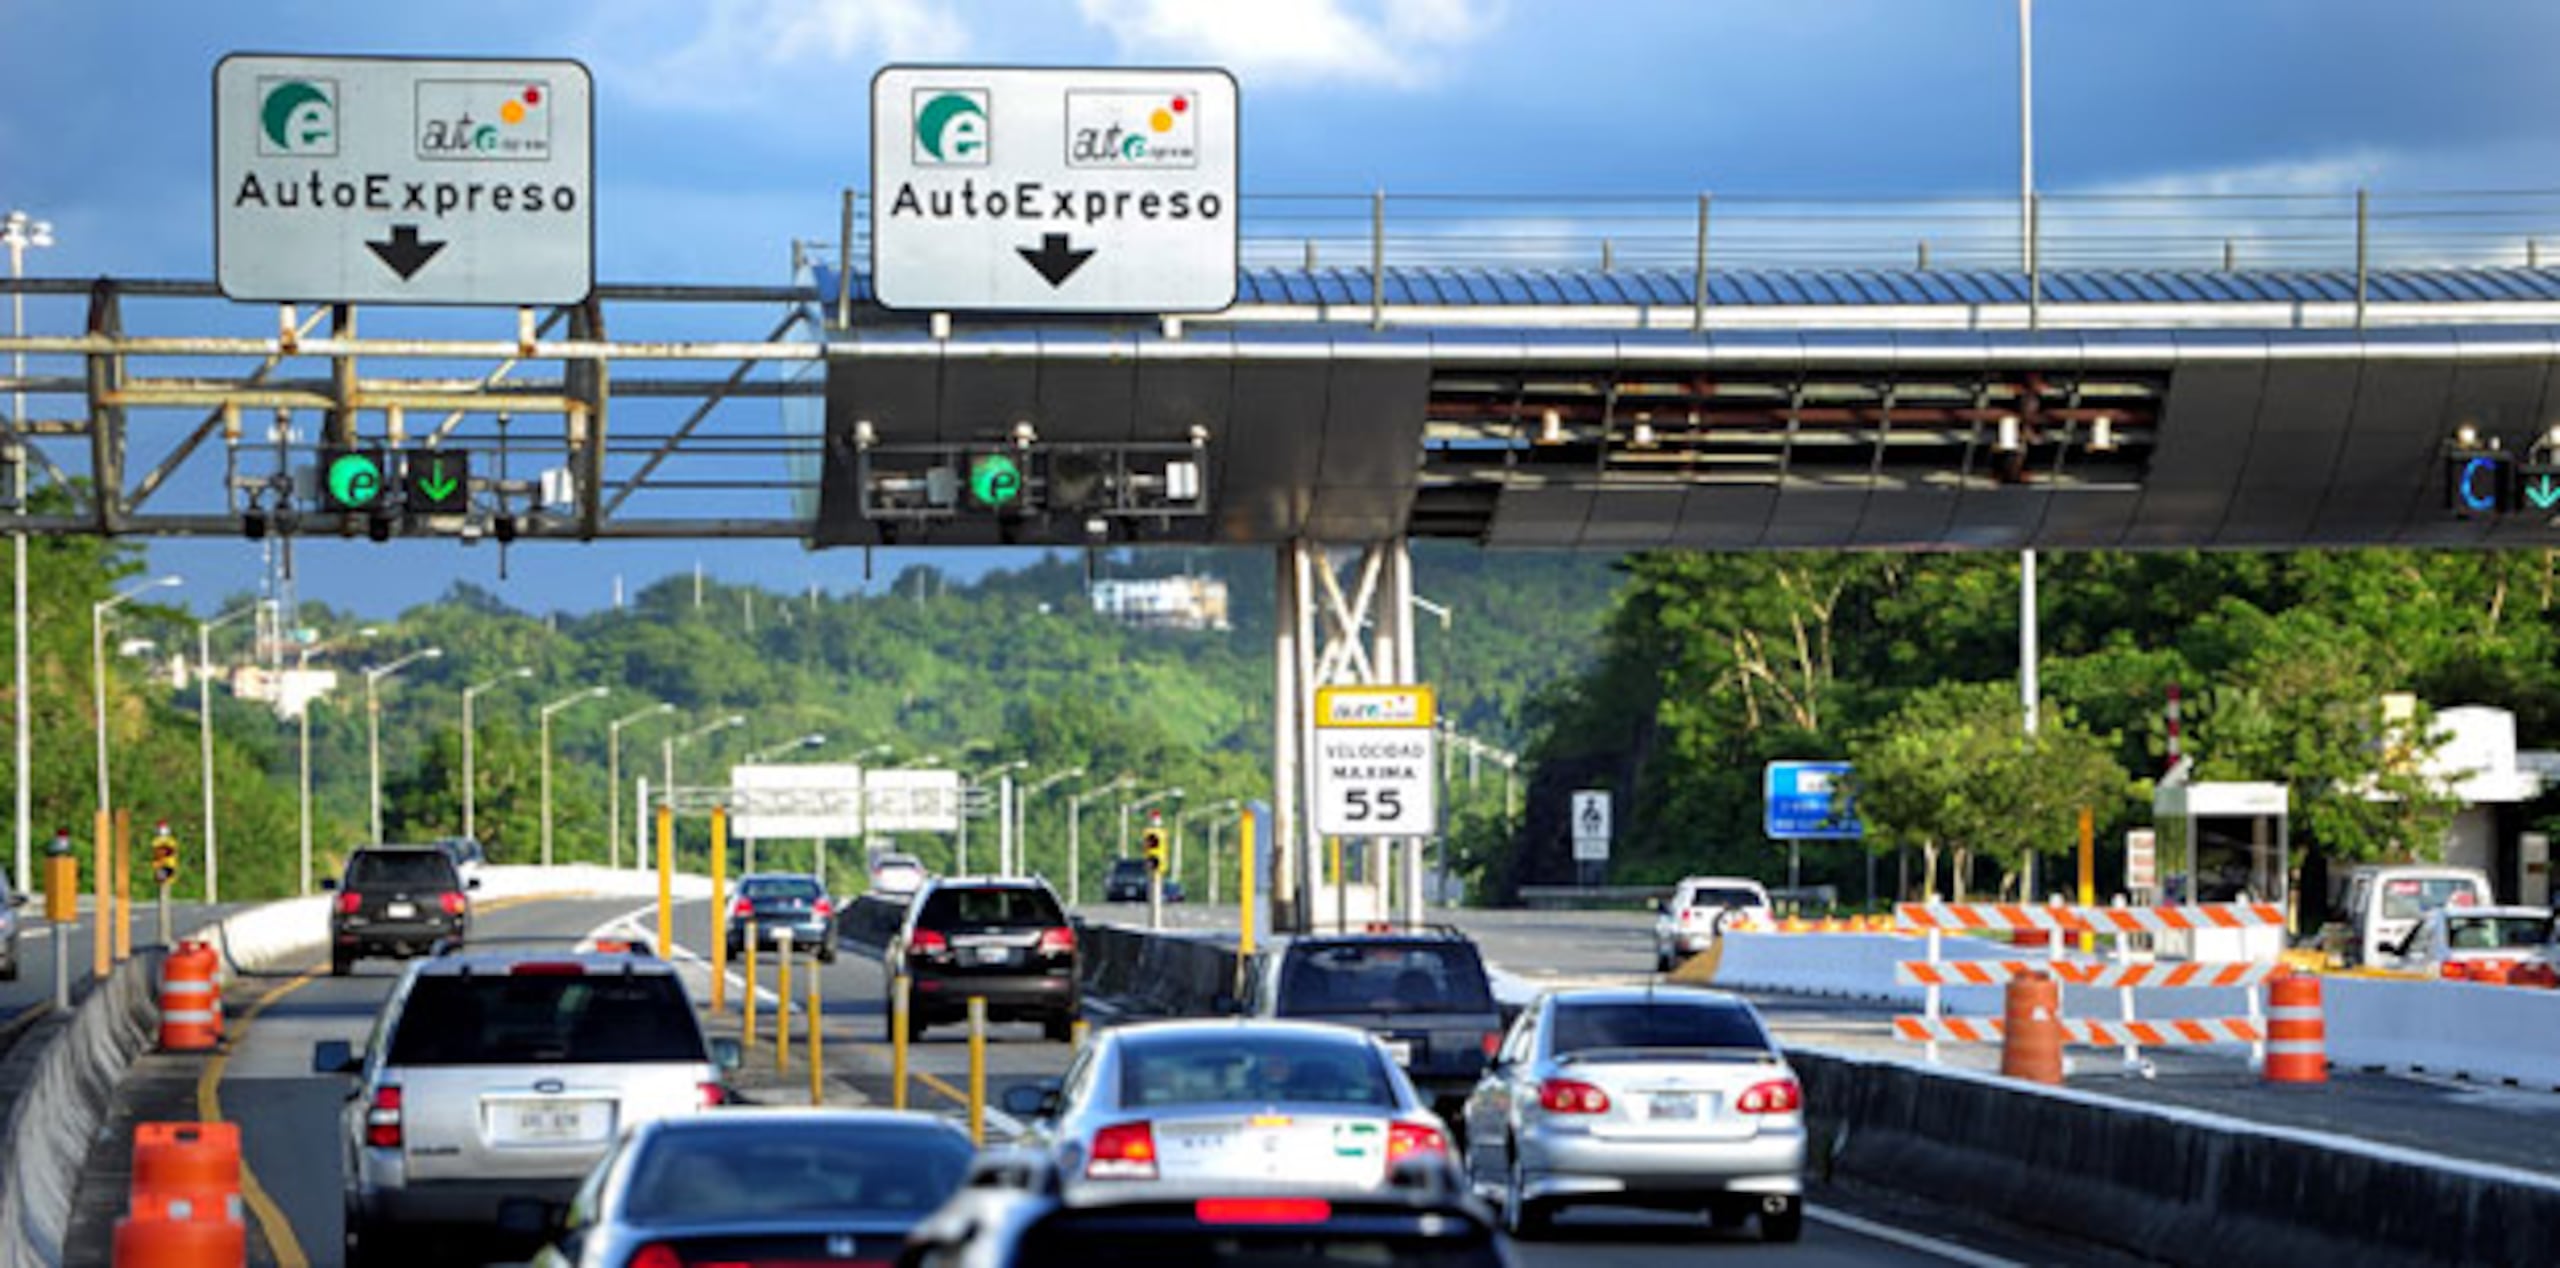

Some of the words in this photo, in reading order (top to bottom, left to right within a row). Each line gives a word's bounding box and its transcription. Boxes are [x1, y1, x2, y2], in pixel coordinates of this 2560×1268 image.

[235, 170, 576, 219] AutoExpreso
[891, 179, 1221, 224] AutoExpreso
[1345, 788, 1403, 821] 55
